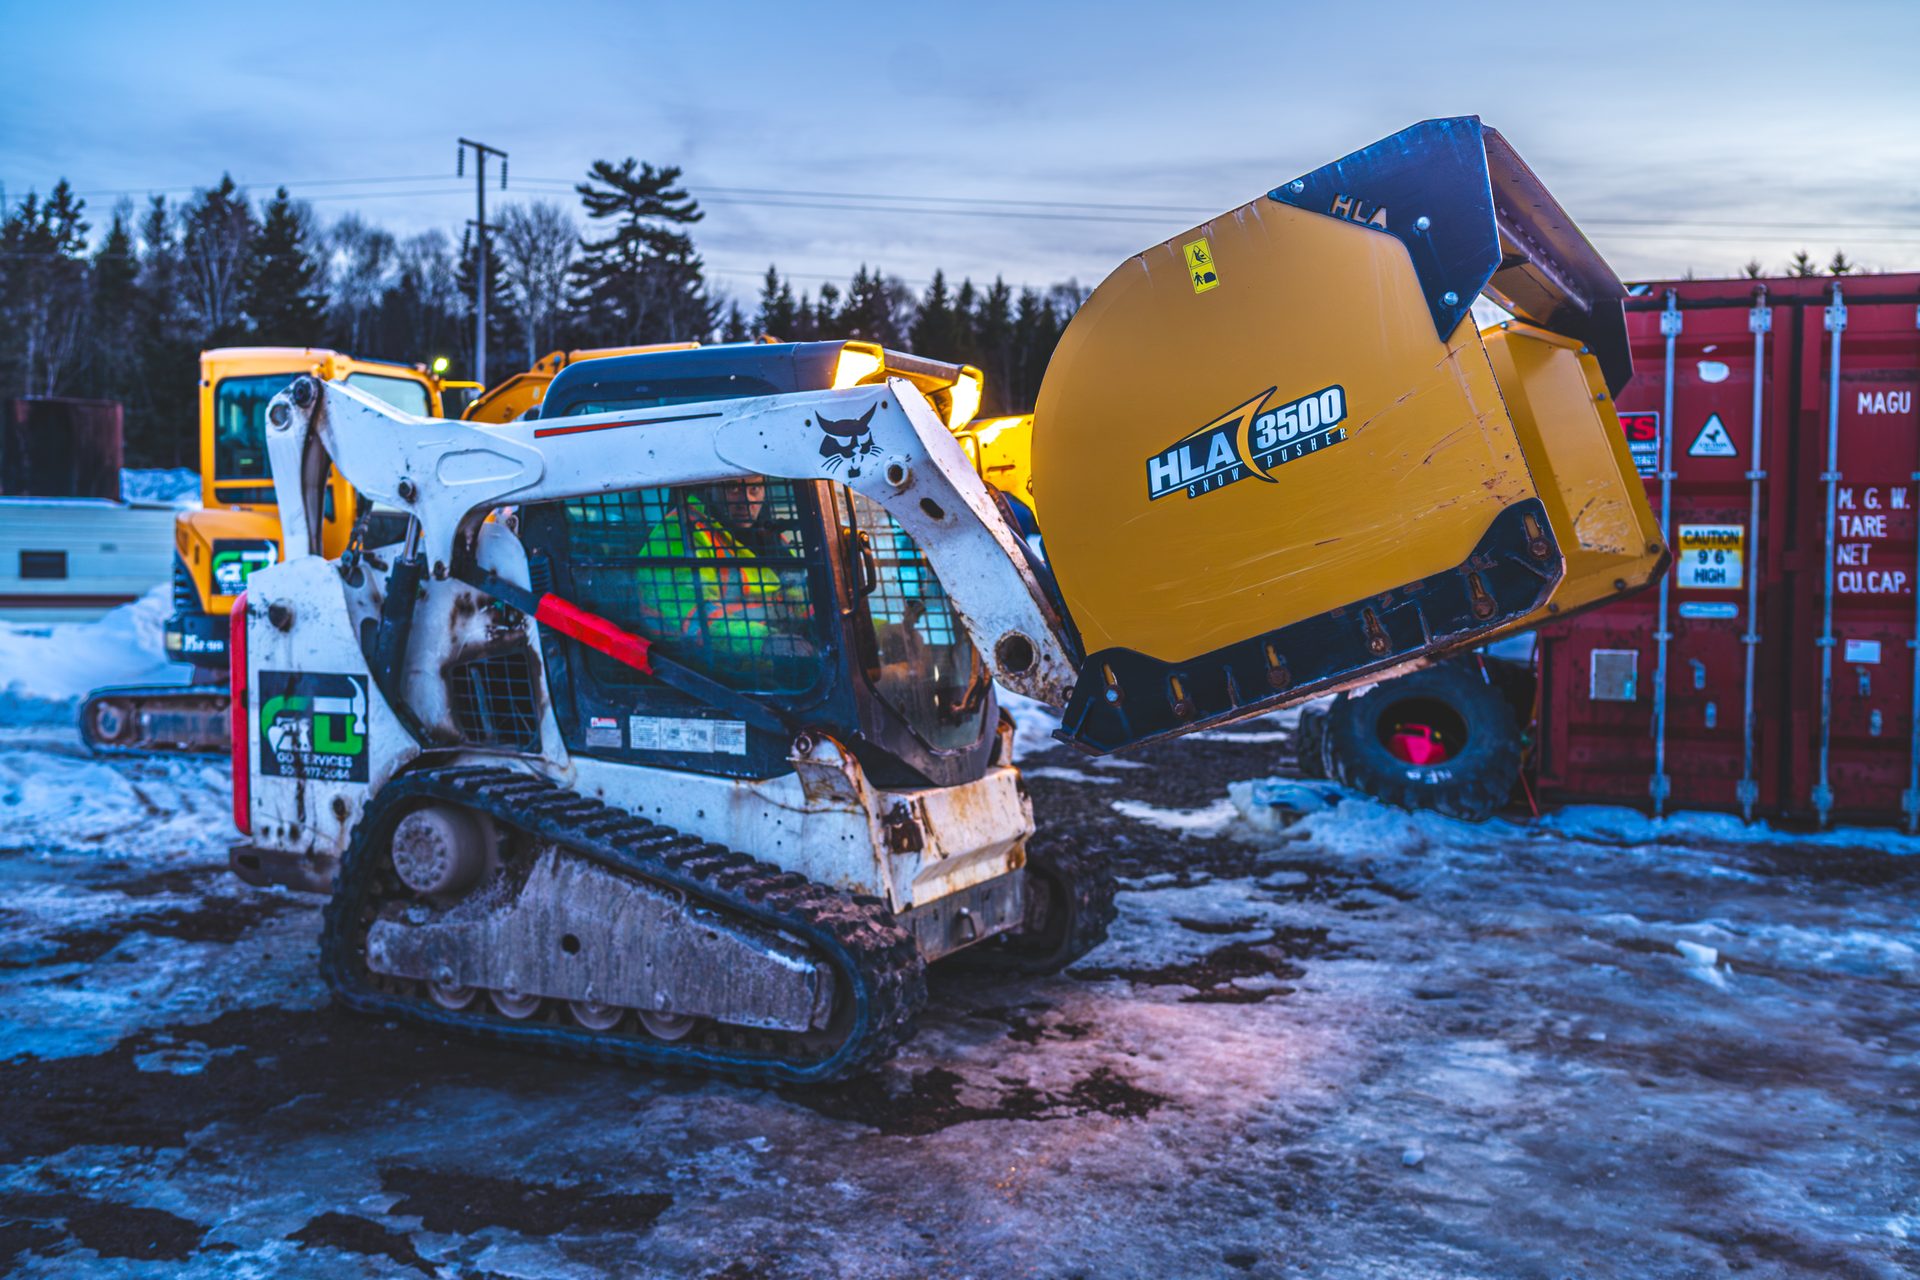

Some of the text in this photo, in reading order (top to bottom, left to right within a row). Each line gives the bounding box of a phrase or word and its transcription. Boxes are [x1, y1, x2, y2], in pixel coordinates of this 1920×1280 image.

[1330, 192, 1388, 229] HLA
[1857, 391, 1912, 415] MAGU
[1150, 388, 1342, 493] HLA 3500
[1189, 427, 1348, 497] SNOW PUSHER
[1839, 515, 1888, 537] TARE
[1683, 530, 1740, 545] CAUTION
[1837, 543, 1872, 565] NET
[1694, 567, 1726, 584] HIGH
[301, 753, 353, 768] ERVICES
